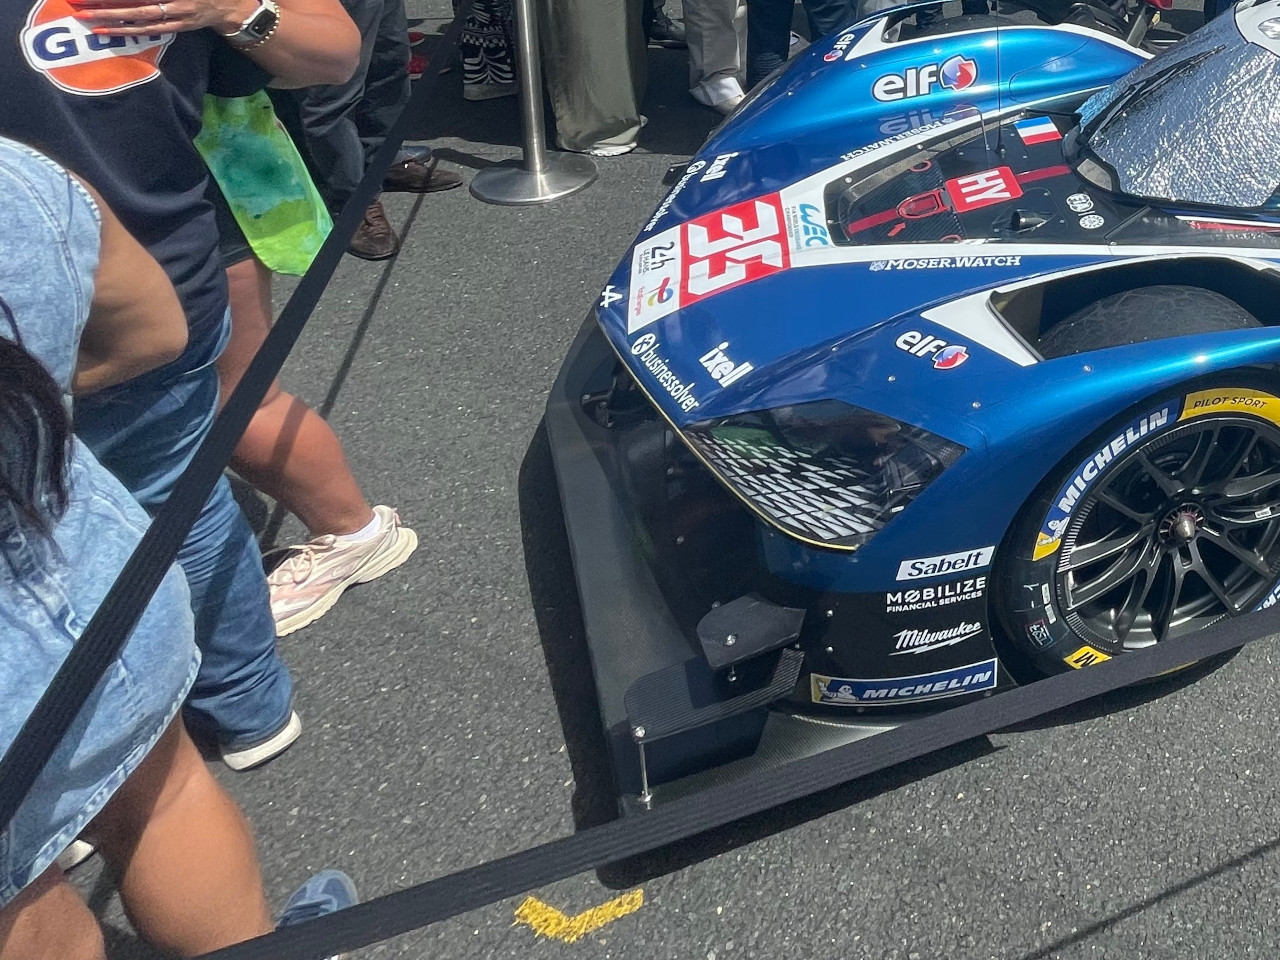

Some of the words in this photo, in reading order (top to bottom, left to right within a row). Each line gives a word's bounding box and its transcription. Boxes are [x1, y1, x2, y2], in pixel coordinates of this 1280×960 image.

[833, 33, 855, 50] elf
[873, 63, 939, 102] elf
[958, 170, 1012, 203] HY
[799, 203, 828, 247] WEC
[688, 200, 784, 295] 35
[884, 256, 1021, 271] MOSER.WATCH
[896, 330, 947, 358] elf
[640, 343, 700, 413] businessolver
[699, 341, 754, 388] ixell
[1193, 396, 1229, 409] PILOT
[1231, 396, 1267, 410] SPORT
[1058, 407, 1169, 514] MICHELIN
[907, 551, 983, 577] Sabelt
[887, 600, 937, 613] FINANCIAL
[939, 590, 982, 606] SERVICES
[893, 621, 981, 650] Milwaukee
[862, 670, 992, 699] MICHELIN
